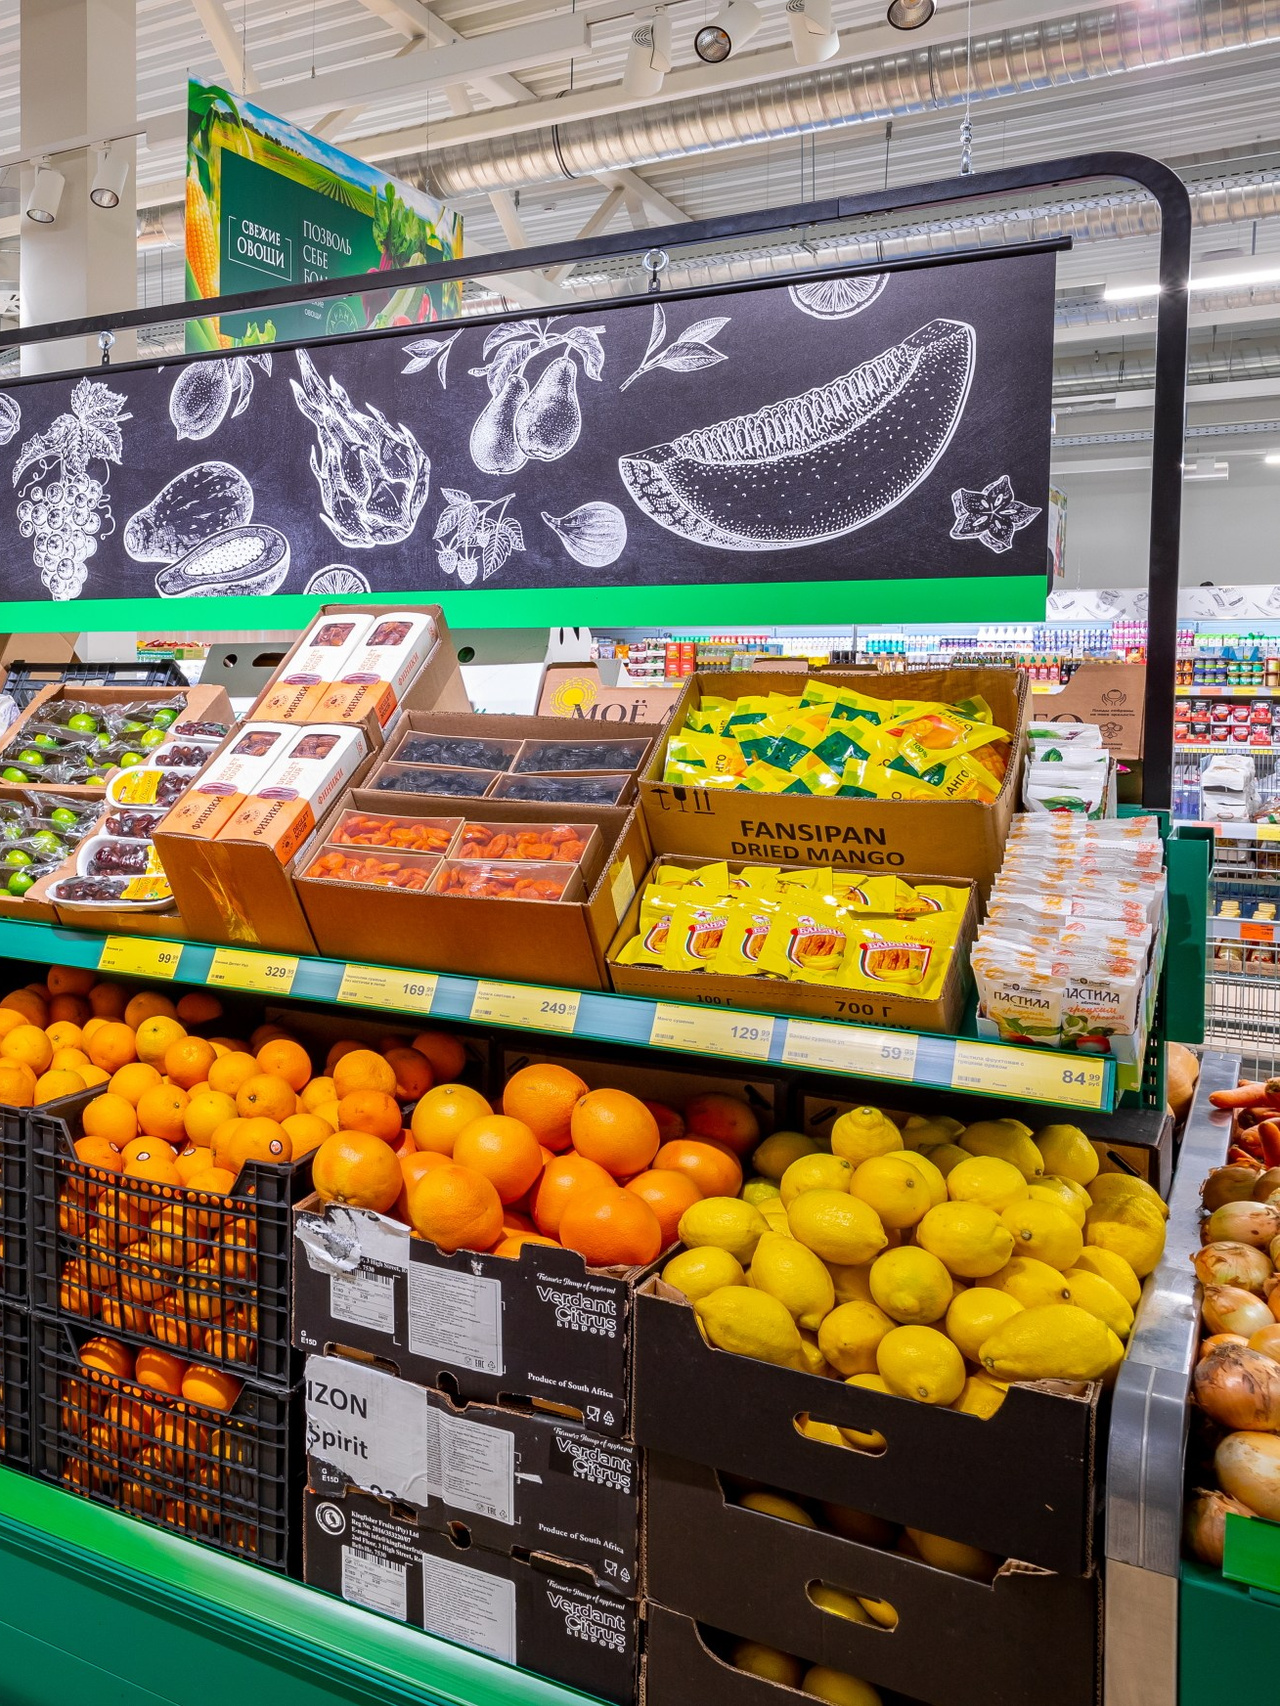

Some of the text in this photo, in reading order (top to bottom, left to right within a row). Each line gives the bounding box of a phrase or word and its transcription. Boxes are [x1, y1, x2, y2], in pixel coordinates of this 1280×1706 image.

[241, 220, 281, 246] СВЕЖИЕ
[303, 220, 352, 255] ПОЗВОЛЬ
[237, 236, 285, 268] ОВОЩИ
[303, 244, 328, 269] СЕБЕ
[283, 685, 310, 719] ФИНИКИ
[342, 685, 369, 719] ФИНИКИ
[192, 796, 224, 830] ФИНИКИ
[253, 801, 284, 836] ФИНИКИ
[292, 811, 309, 833] DEGLET
[740, 820, 886, 845] FANSIPAN
[731, 841, 905, 866] DRIED MANGO
[158, 953, 172, 963] 99
[265, 966, 286, 977] 329
[402, 984, 425, 996] 169
[696, 994, 721, 1005] 100
[993, 991, 1050, 1009] ПАСТИЛА
[1062, 987, 1120, 1004] ПАСТИЛА
[540, 1001, 567, 1014] 249
[835, 1001, 892, 1017] 700 Г
[730, 1026, 759, 1041] 129
[880, 1046, 901, 1060] 59
[1062, 1070, 1086, 1085] 84
[536, 1285, 617, 1315] Verdant
[554, 1304, 617, 1332] Citrus
[557, 1320, 615, 1338] LIMPOPO
[300, 1336, 318, 1346] E15D
[528, 1372, 614, 1398] Produce of South Africa
[307, 1380, 367, 1419] IZON
[307, 1421, 368, 1460] Spirit
[556, 1437, 632, 1474] Verdant
[322, 1474, 339, 1483] E15D
[572, 1458, 631, 1488] Citrus
[573, 1470, 631, 1494] LIMPOPO
[351, 1510, 420, 1538] Kingfisher Fruits (Pty) Ltd
[351, 1518, 372, 1530] Reg No.
[351, 1525, 371, 1538] E-mail:
[351, 1533, 362, 1542] 2nd
[362, 1537, 378, 1548] Floor,
[382, 1543, 395, 1554] High
[538, 1523, 567, 1537] Produce
[579, 1533, 601, 1545] South
[603, 1540, 624, 1554] Africa
[546, 1591, 625, 1631] Verdant
[564, 1612, 626, 1647] Citrus
[566, 1628, 625, 1653] LIMPOPO
